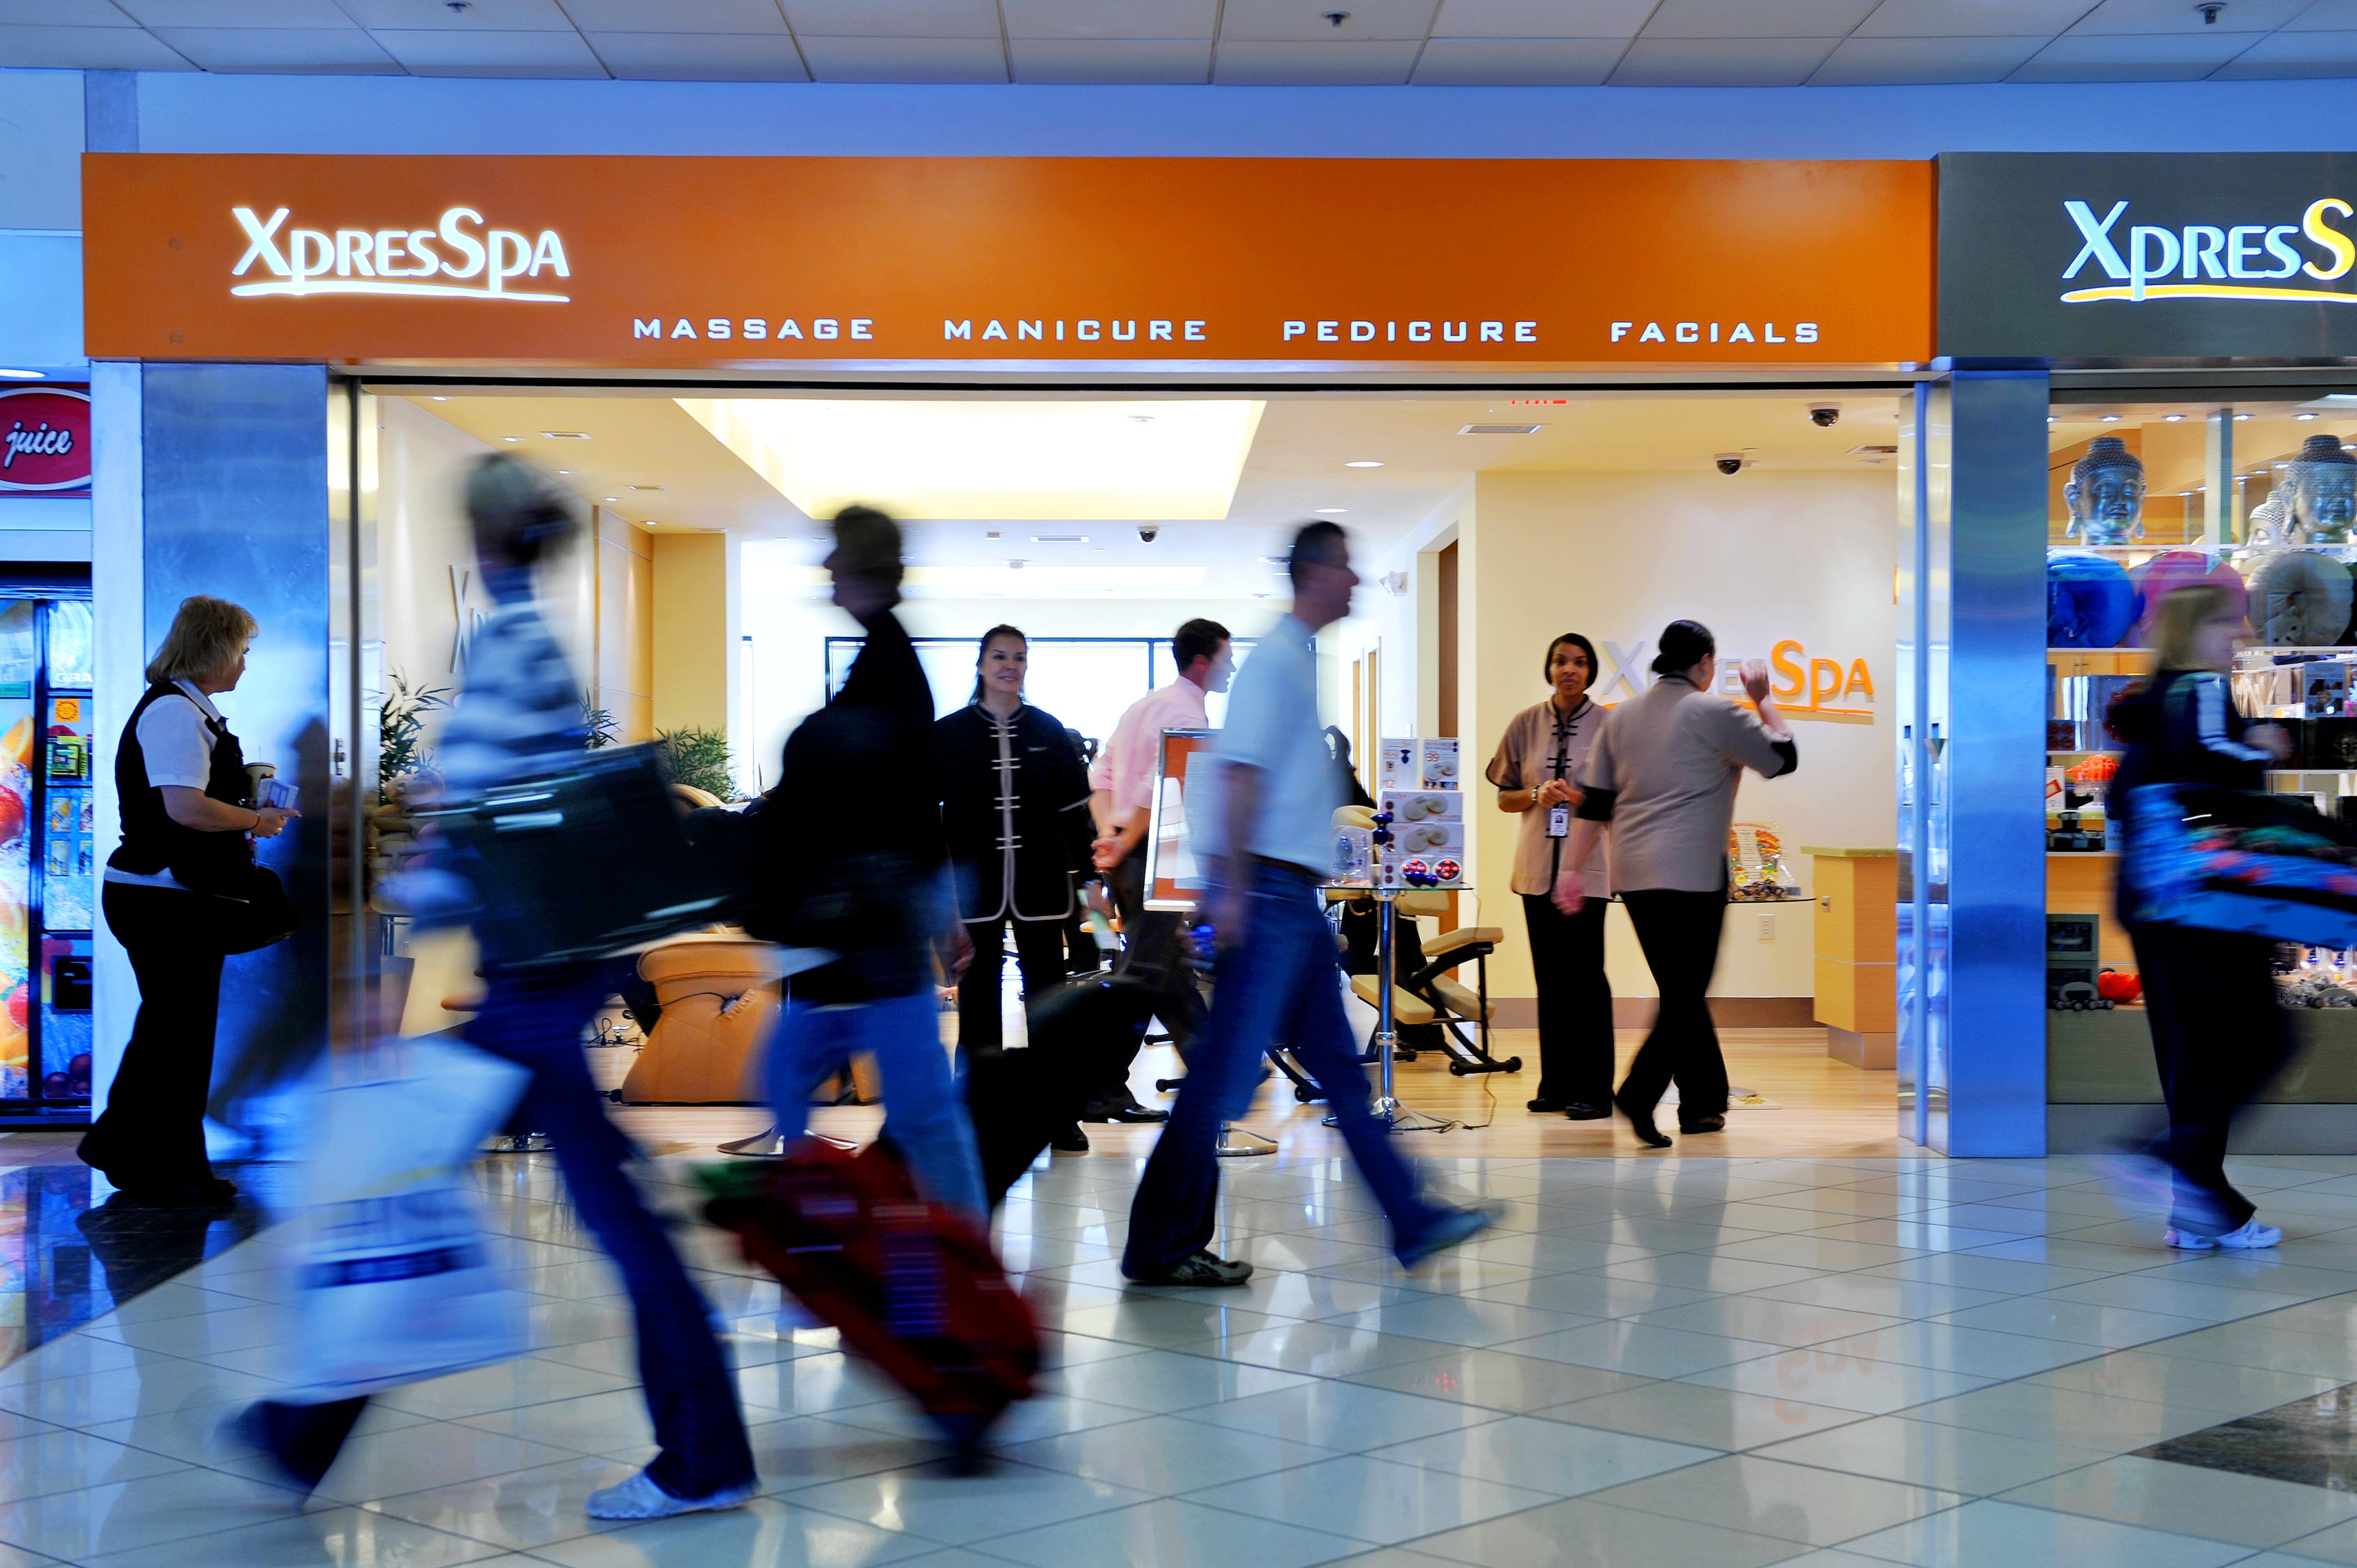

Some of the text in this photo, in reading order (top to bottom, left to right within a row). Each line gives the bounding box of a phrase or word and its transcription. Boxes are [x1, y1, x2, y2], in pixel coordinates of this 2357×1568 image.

[633, 317, 1819, 344] MASSAGE MANICURE PEDICURE FACIALS
[3, 421, 74, 468] juice
